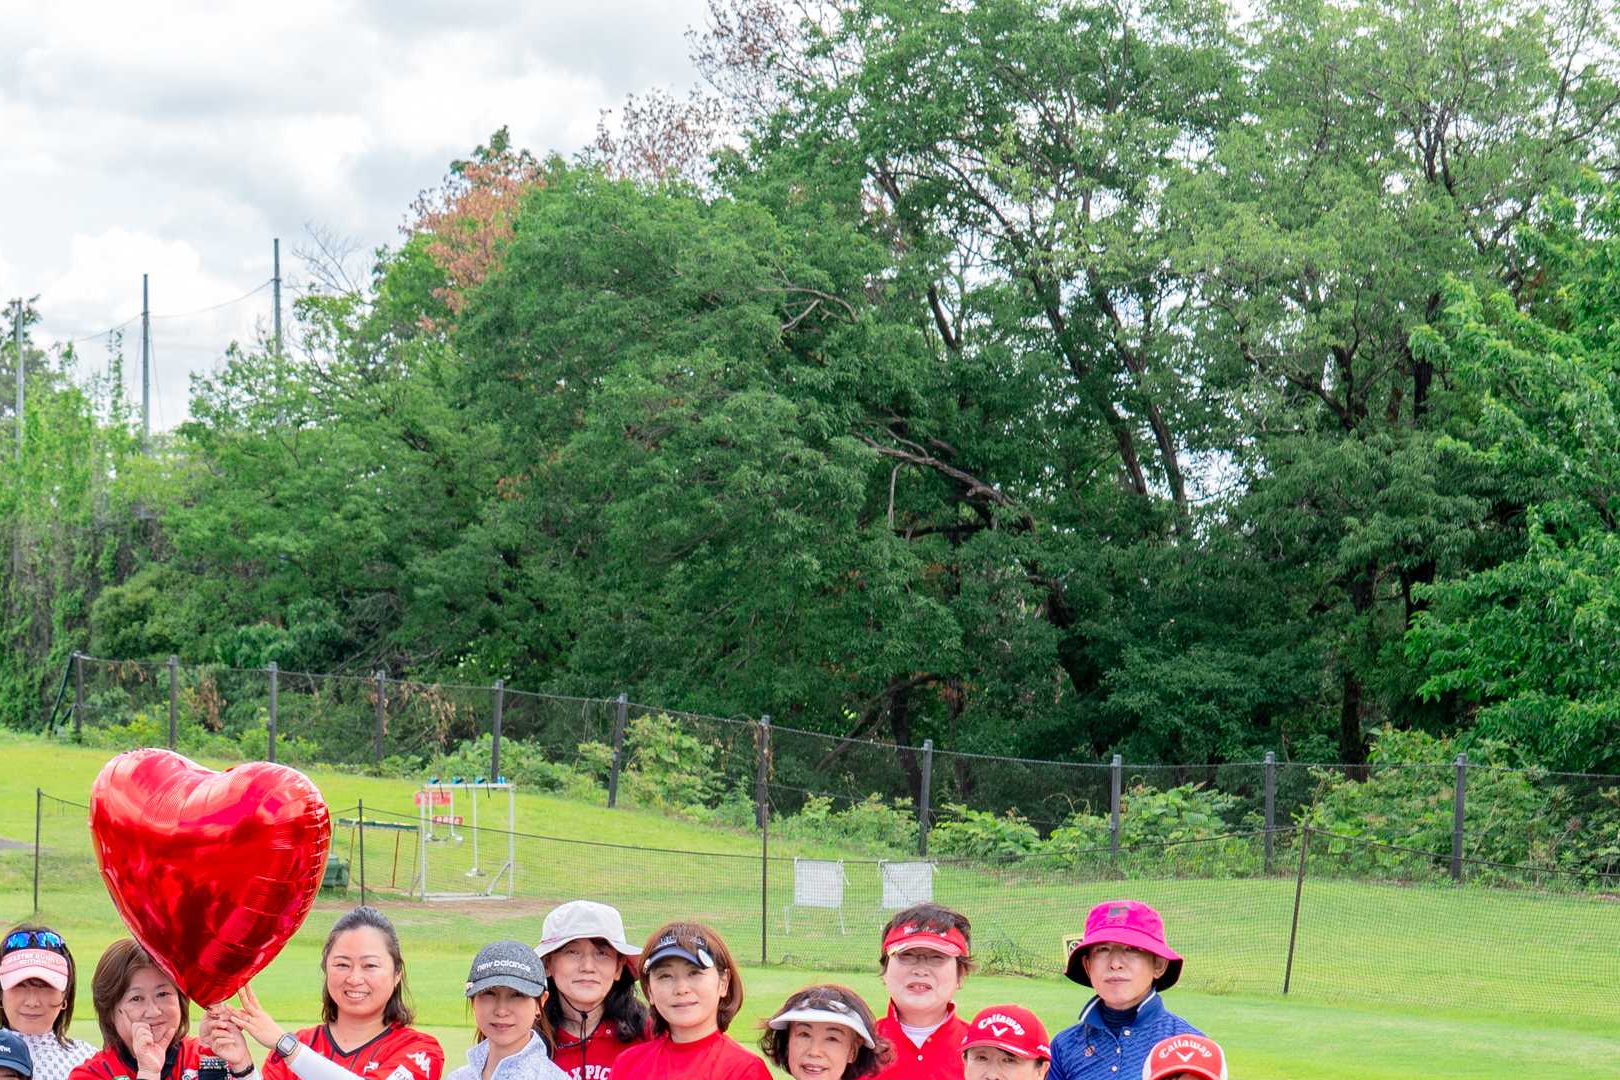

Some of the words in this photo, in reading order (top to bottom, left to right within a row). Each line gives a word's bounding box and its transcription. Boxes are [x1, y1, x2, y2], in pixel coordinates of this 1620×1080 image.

[494, 960, 531, 974] balance
[978, 1014, 1025, 1036] Callaway
[1159, 1039, 1213, 1059] Callaway
